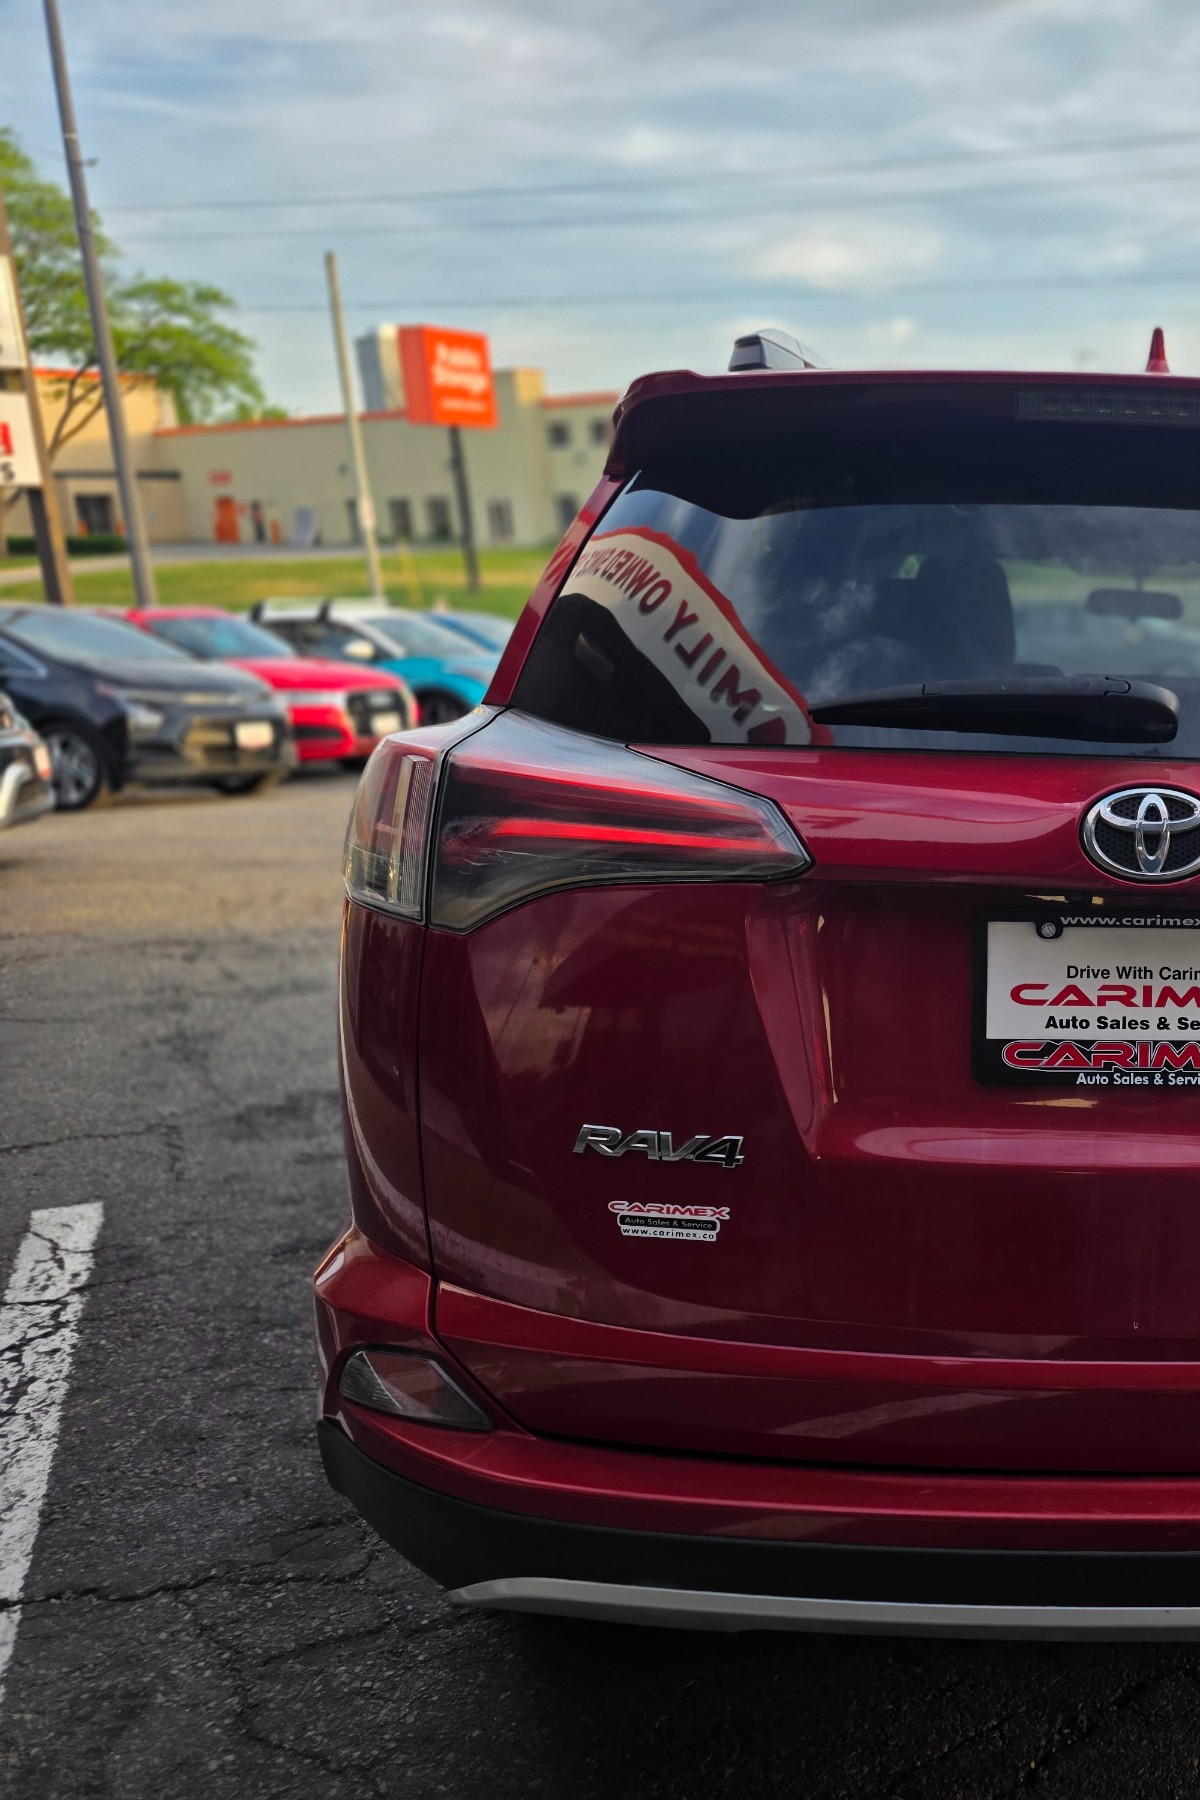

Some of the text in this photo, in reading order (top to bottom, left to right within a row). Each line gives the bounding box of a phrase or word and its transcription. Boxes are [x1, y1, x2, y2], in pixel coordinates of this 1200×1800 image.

[1066, 965, 1111, 979] Drive
[1115, 965, 1153, 980] With
[1045, 1015, 1091, 1030] Auto
[1096, 1015, 1150, 1031] Sales
[1156, 1016, 1171, 1031] &
[1076, 1072, 1109, 1085] Auto
[1113, 1073, 1149, 1085] Sales
[1153, 1073, 1164, 1085] &
[572, 1124, 745, 1168] RAV4
[609, 1201, 729, 1218] CARIMEX
[624, 1217, 713, 1229] Auto Sales & Service
[622, 1228, 715, 1240] www.carimex.ca
